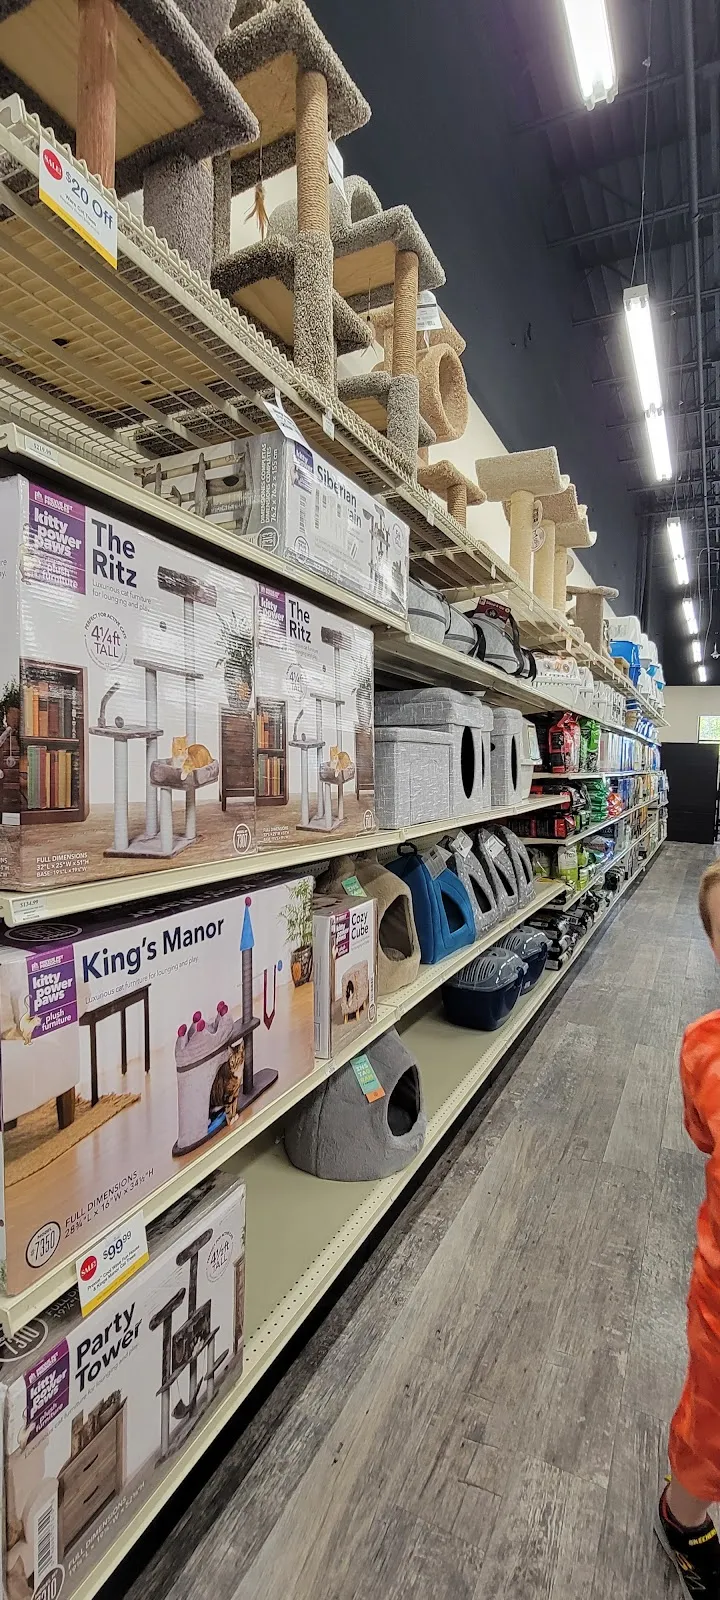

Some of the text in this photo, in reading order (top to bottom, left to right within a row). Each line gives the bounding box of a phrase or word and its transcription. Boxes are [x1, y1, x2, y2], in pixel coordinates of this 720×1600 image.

[65, 171, 89, 205] $20
[92, 199, 113, 230] Off
[317, 465, 357, 508] Siberian
[34, 507, 69, 533] kitty
[38, 525, 82, 550] power
[91, 518, 136, 560] The
[92, 548, 137, 589] Ritz
[120, 589, 129, 597] cat
[289, 600, 310, 624] The
[289, 621, 311, 643] Ritz
[94, 642, 119, 658] TALL
[52, 852, 88, 862] DIMENSIONS
[352, 911, 368, 926] Cozy
[352, 925, 369, 940] Cube
[83, 919, 224, 983] King's Manor
[32, 972, 61, 989] kitty
[36, 977, 73, 1000] power
[85, 987, 115, 1004] Luxurious
[115, 984, 124, 992] cat
[124, 975, 147, 990] furniture
[148, 972, 156, 980] for
[156, 963, 179, 977] lounging
[179, 959, 188, 968] and
[34, 990, 65, 1012] paws
[42, 1014, 71, 1031] furniture
[45, 1009, 64, 1024] plush
[65, 1170, 137, 1228] FULL DIMENSIONS
[80, 1260, 97, 1277] SALE!
[47, 1293, 70, 1316] FULL
[76, 1301, 136, 1369] Party
[75, 1318, 143, 1392] Tower
[30, 1369, 57, 1400] kitty
[33, 1368, 68, 1406] power
[30, 1386, 59, 1420] paws
[39, 1402, 58, 1424] plush
[35, 1403, 63, 1432] furniture
[68, 1495, 127, 1570] FULL DIMENSIONS
